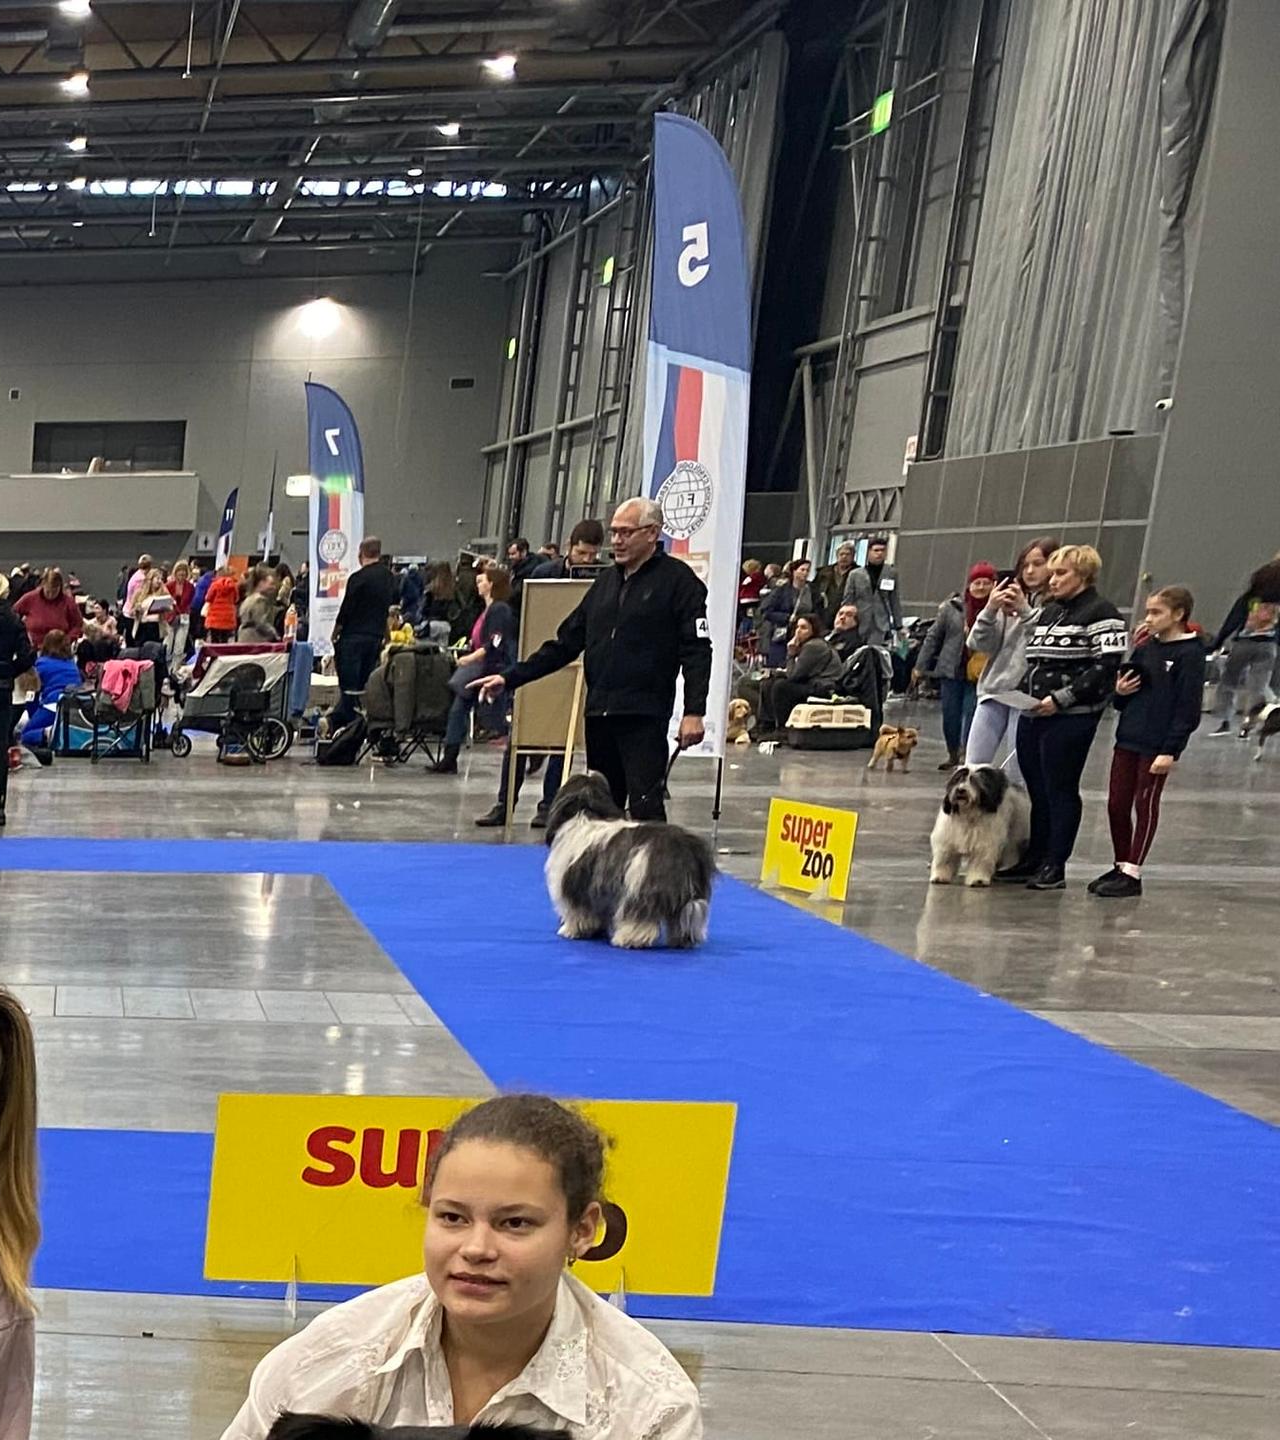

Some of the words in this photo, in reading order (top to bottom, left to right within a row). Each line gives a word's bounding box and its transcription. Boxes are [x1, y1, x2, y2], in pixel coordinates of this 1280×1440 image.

[1103, 635, 1127, 648] 441
[780, 813, 834, 853] super
[801, 849, 835, 881] zoo
